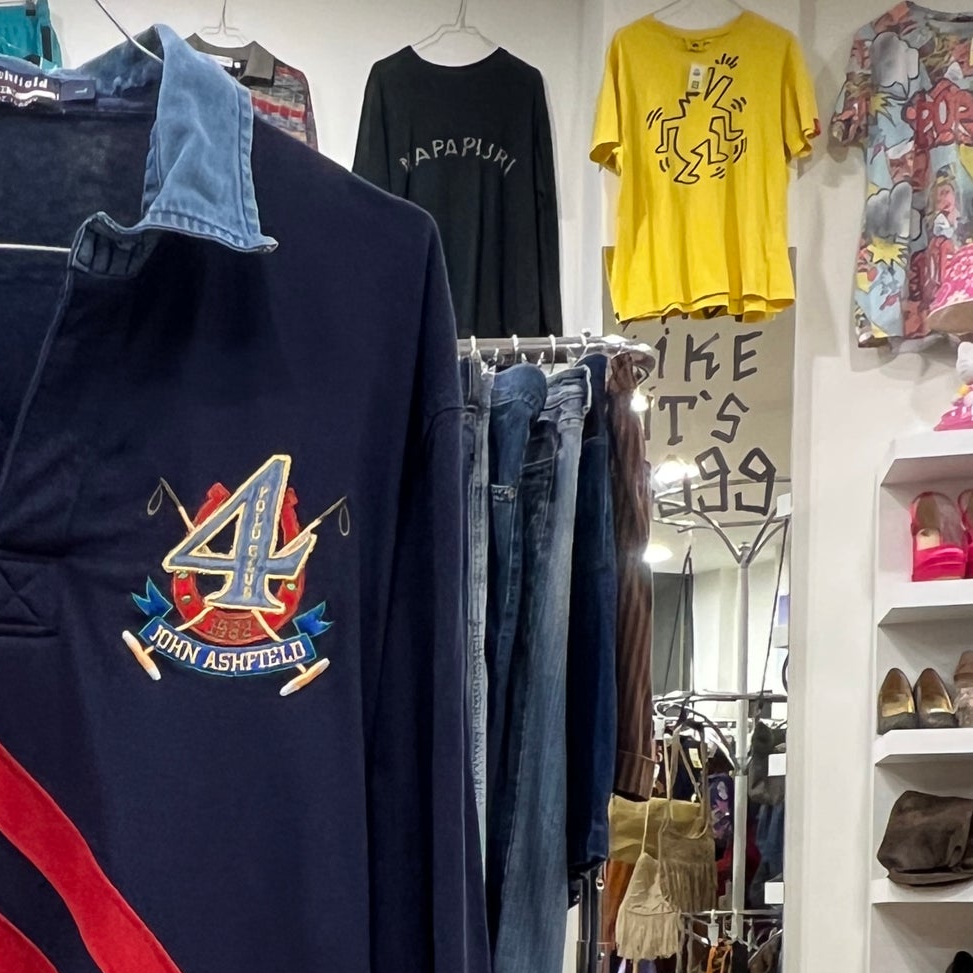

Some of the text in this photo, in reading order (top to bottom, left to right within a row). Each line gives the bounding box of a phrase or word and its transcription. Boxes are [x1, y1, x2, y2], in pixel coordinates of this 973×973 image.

[655, 327, 763, 382] IKE
[162, 454, 317, 614] 4
[149, 624, 307, 672] JOHN ASHFIELD
